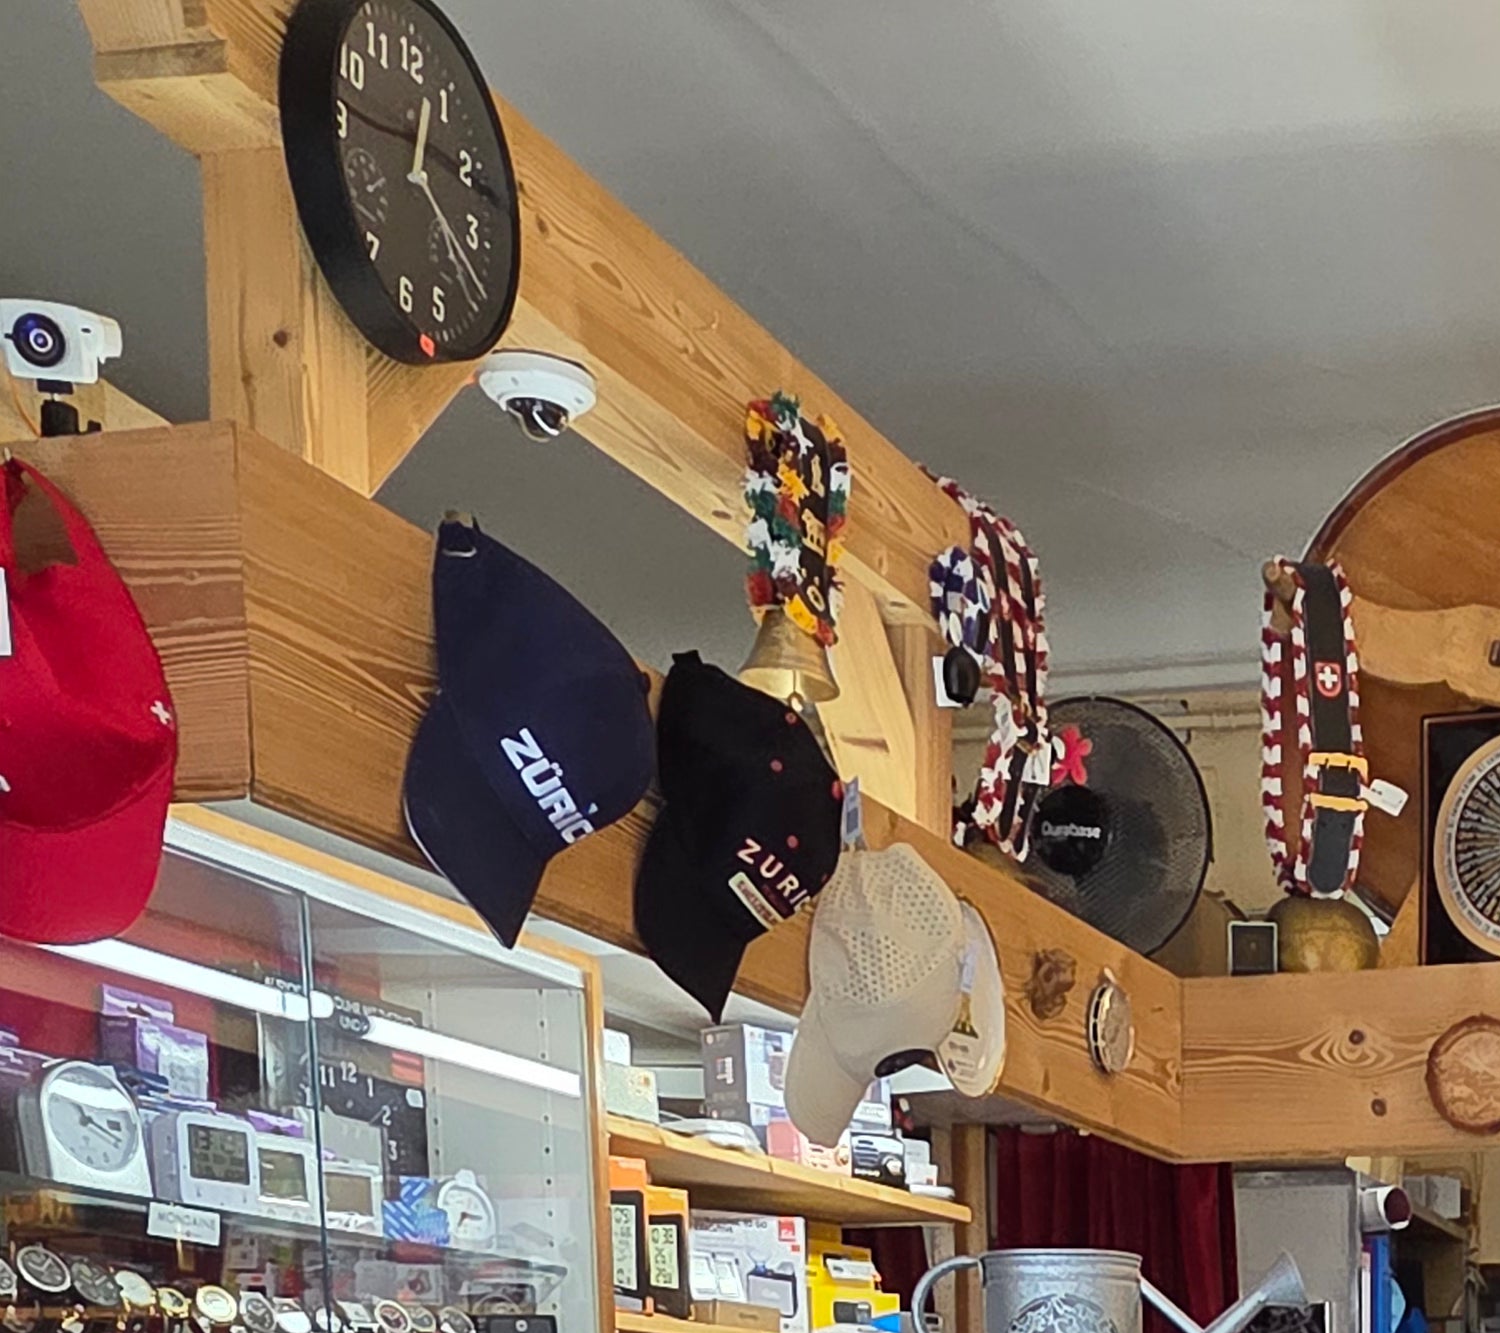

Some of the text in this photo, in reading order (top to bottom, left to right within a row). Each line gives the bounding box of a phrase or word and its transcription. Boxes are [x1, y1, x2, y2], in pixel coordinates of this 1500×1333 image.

[366, 22, 388, 69] 11
[400, 36, 424, 85] 12
[340, 42, 364, 90] 10
[439, 89, 448, 123] 1
[459, 150, 472, 187] 2
[466, 214, 479, 250] 3
[399, 276, 413, 312] 6
[432, 286, 445, 322] 5
[319, 1065, 335, 1088] 11
[340, 1060, 357, 1083] 12
[367, 1077, 374, 1098] 1
[381, 1105, 391, 1126] 2
[389, 1140, 398, 1161] 3
